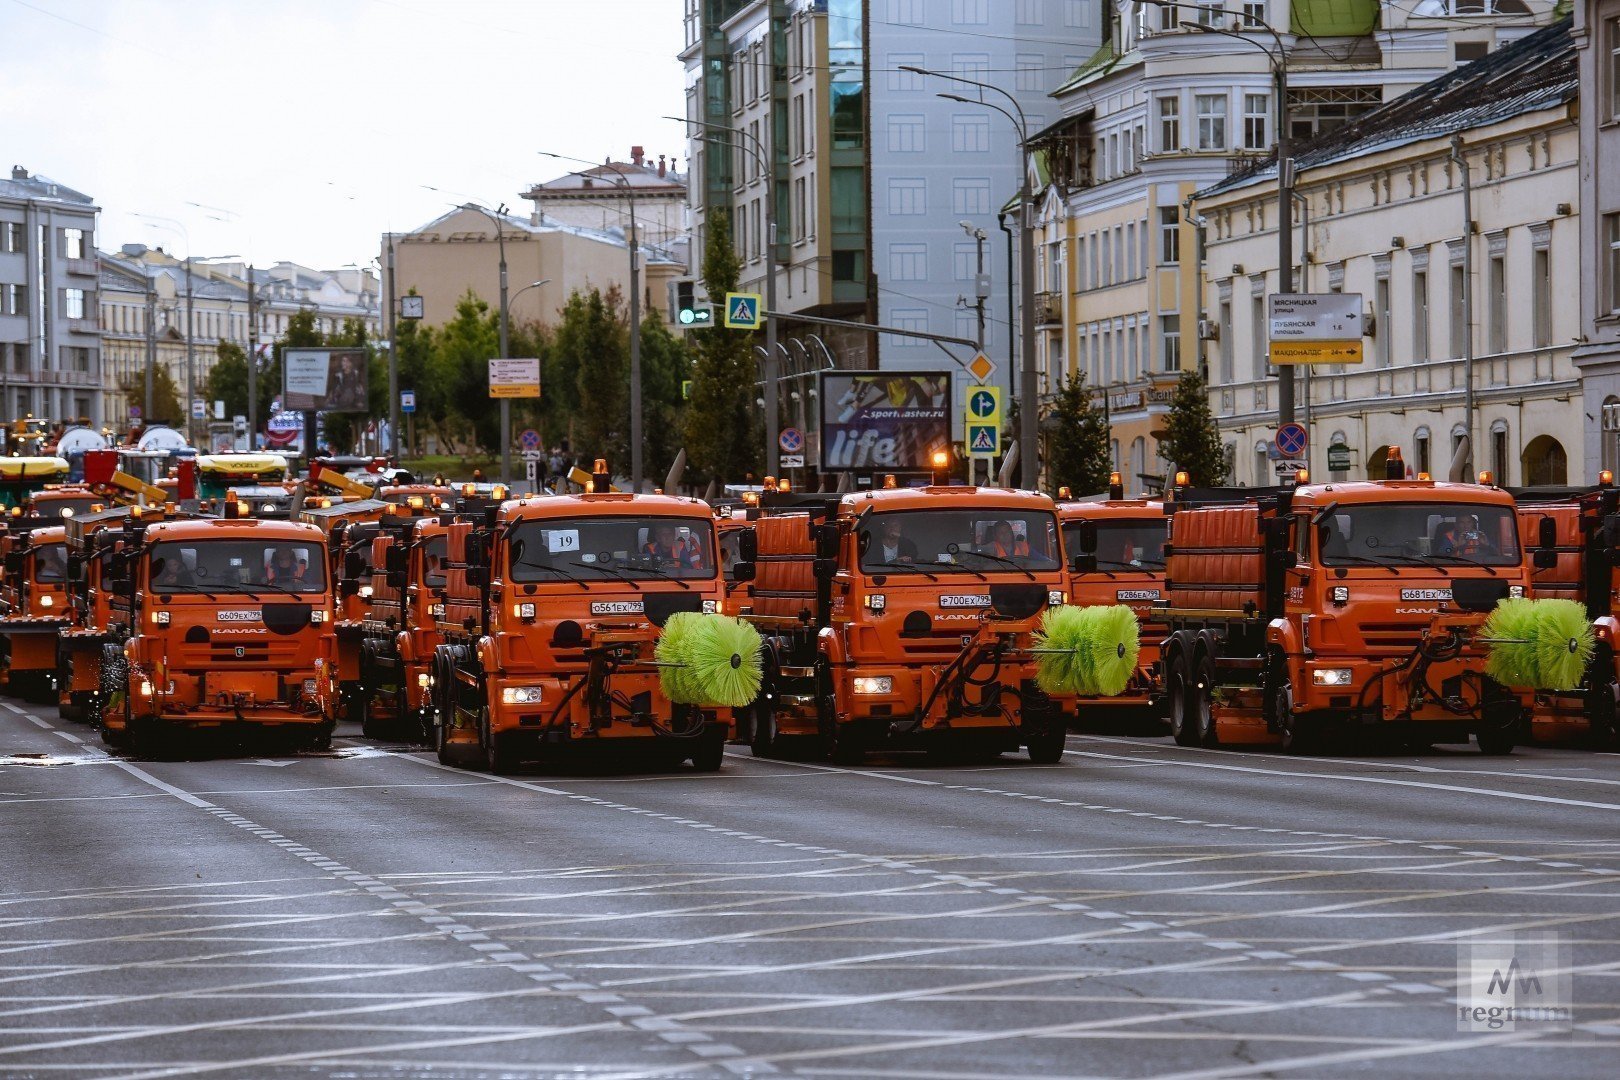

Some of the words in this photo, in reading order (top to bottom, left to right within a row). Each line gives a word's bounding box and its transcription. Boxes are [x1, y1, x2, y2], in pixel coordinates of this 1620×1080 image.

[1274, 299, 1317, 307] МЯСНИЦКАЯ
[1274, 349, 1322, 357] МАКДОНАЛДС
[830, 429, 896, 467] life
[559, 536, 573, 547] 19
